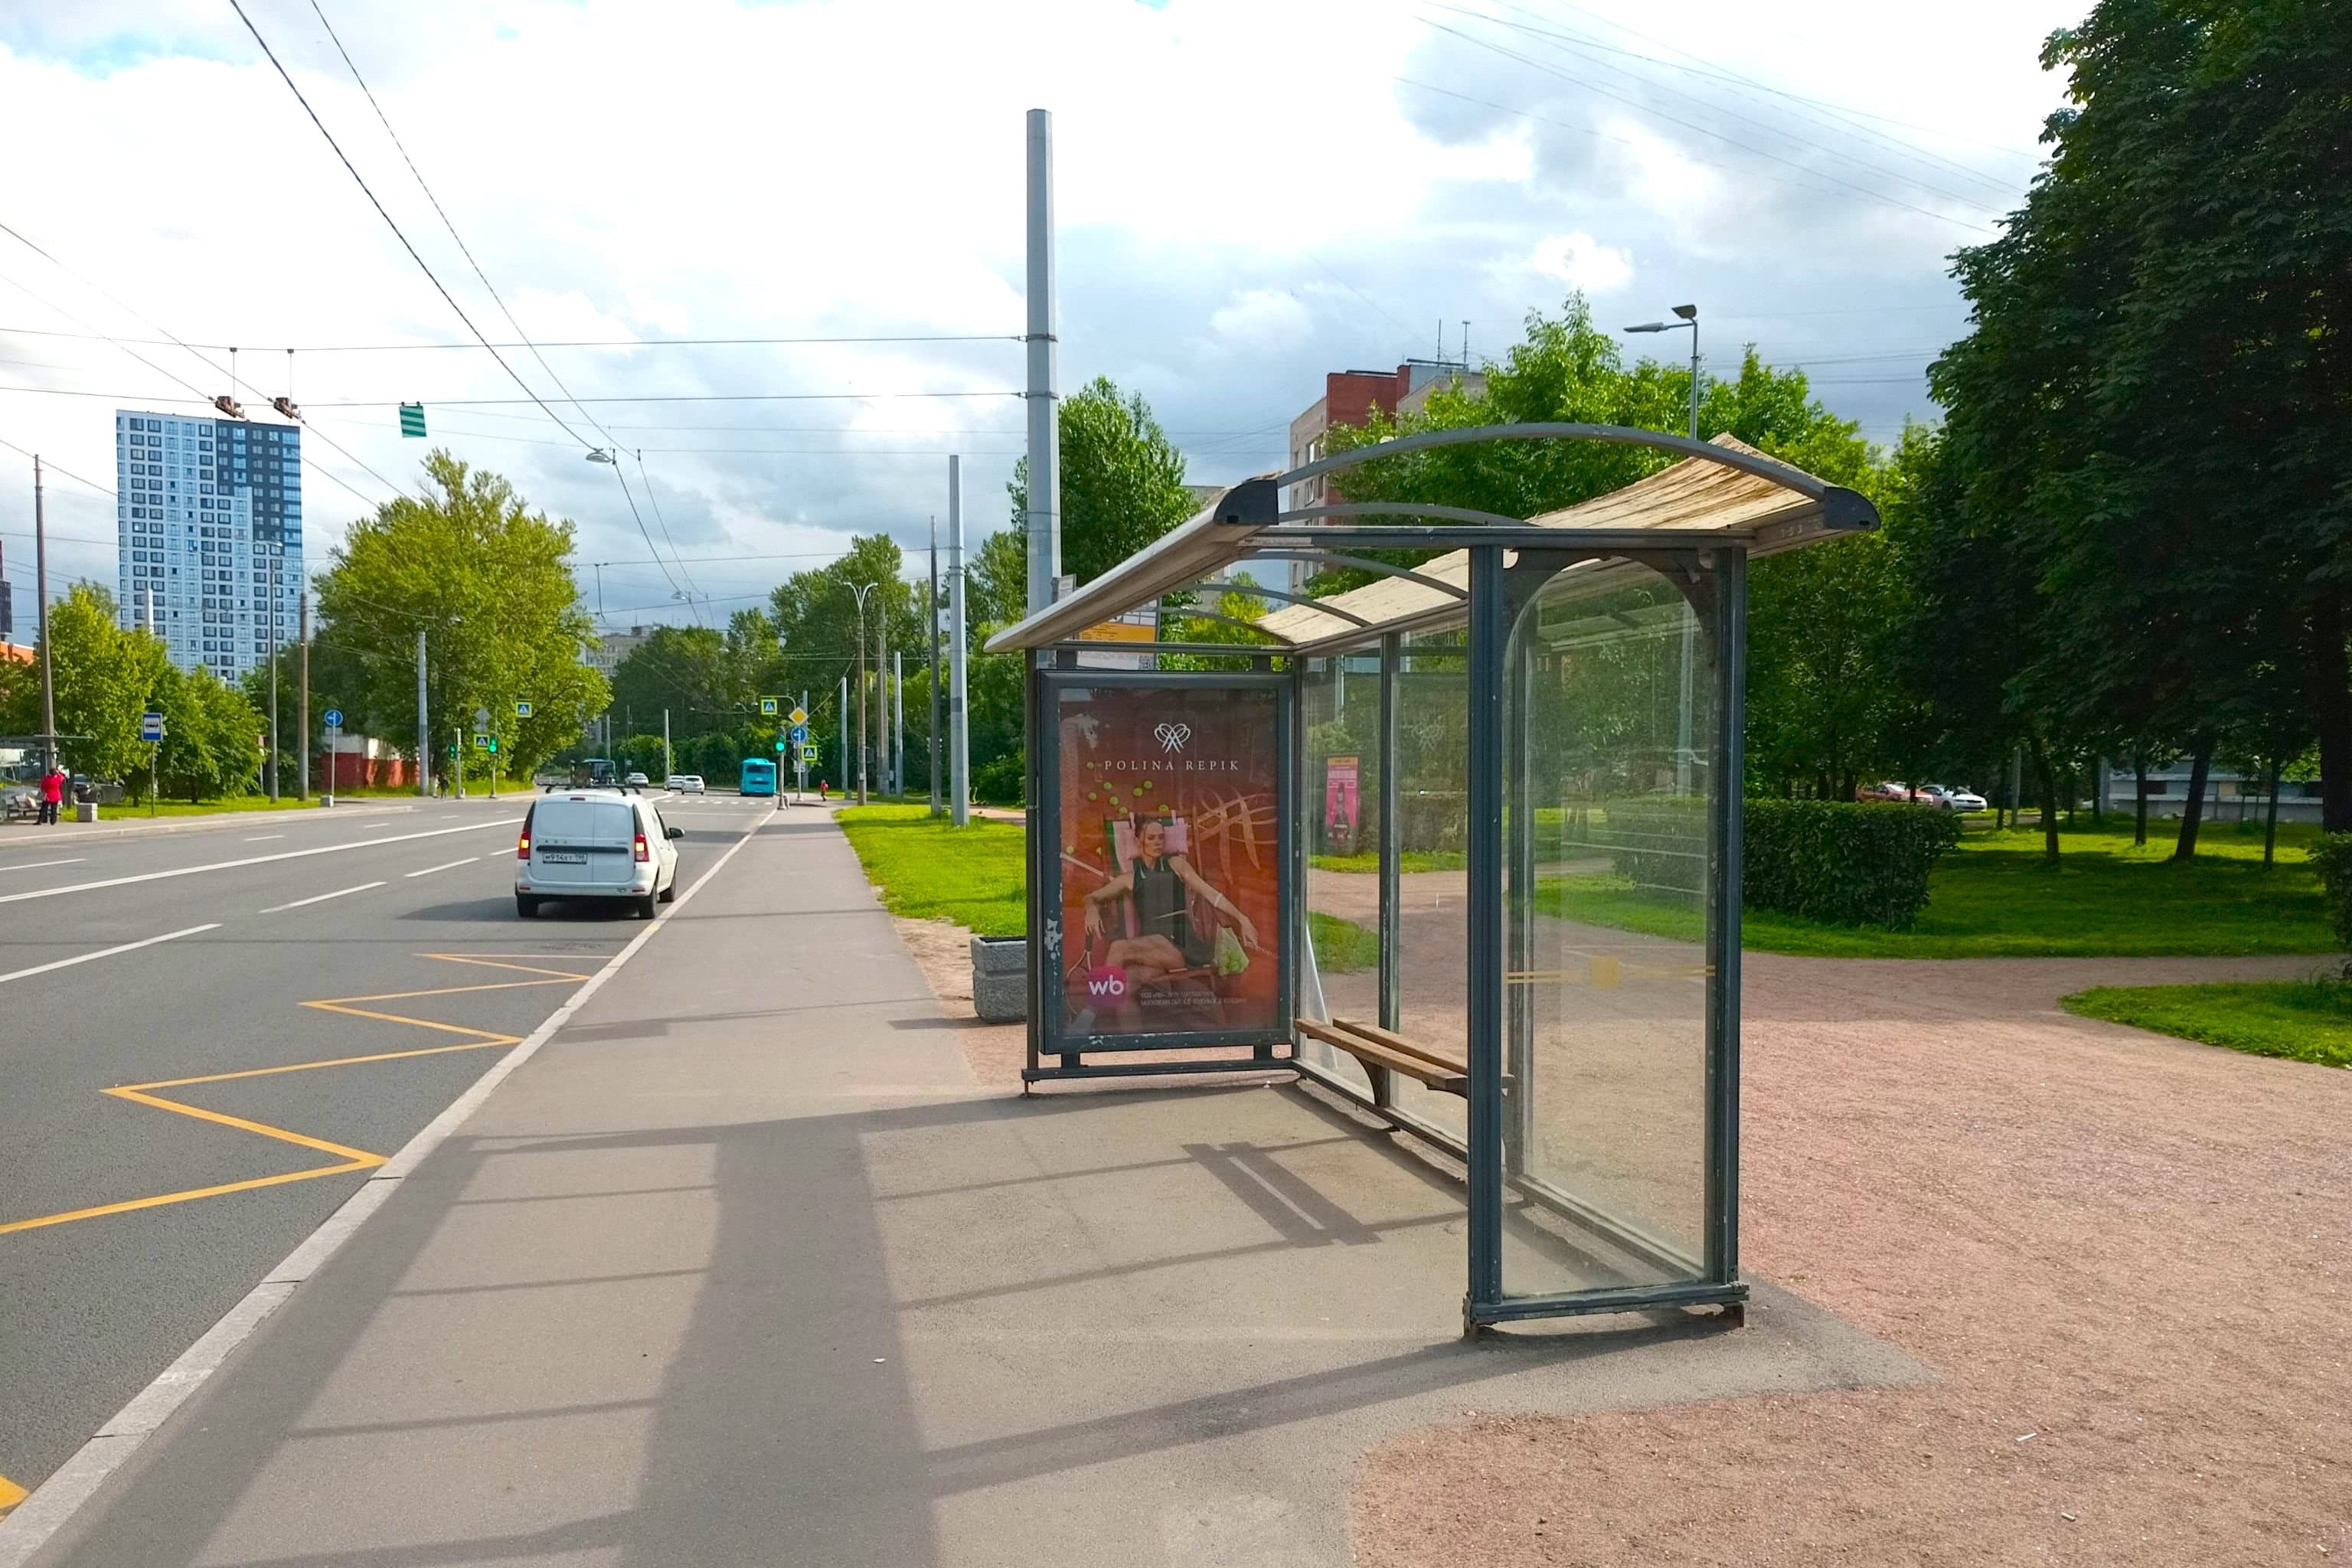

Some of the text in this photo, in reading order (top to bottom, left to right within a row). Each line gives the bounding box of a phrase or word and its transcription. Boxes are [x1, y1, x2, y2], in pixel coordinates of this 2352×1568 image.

[1105, 760, 1239, 771] POLINA REPIK
[1088, 974, 1125, 995] wb
